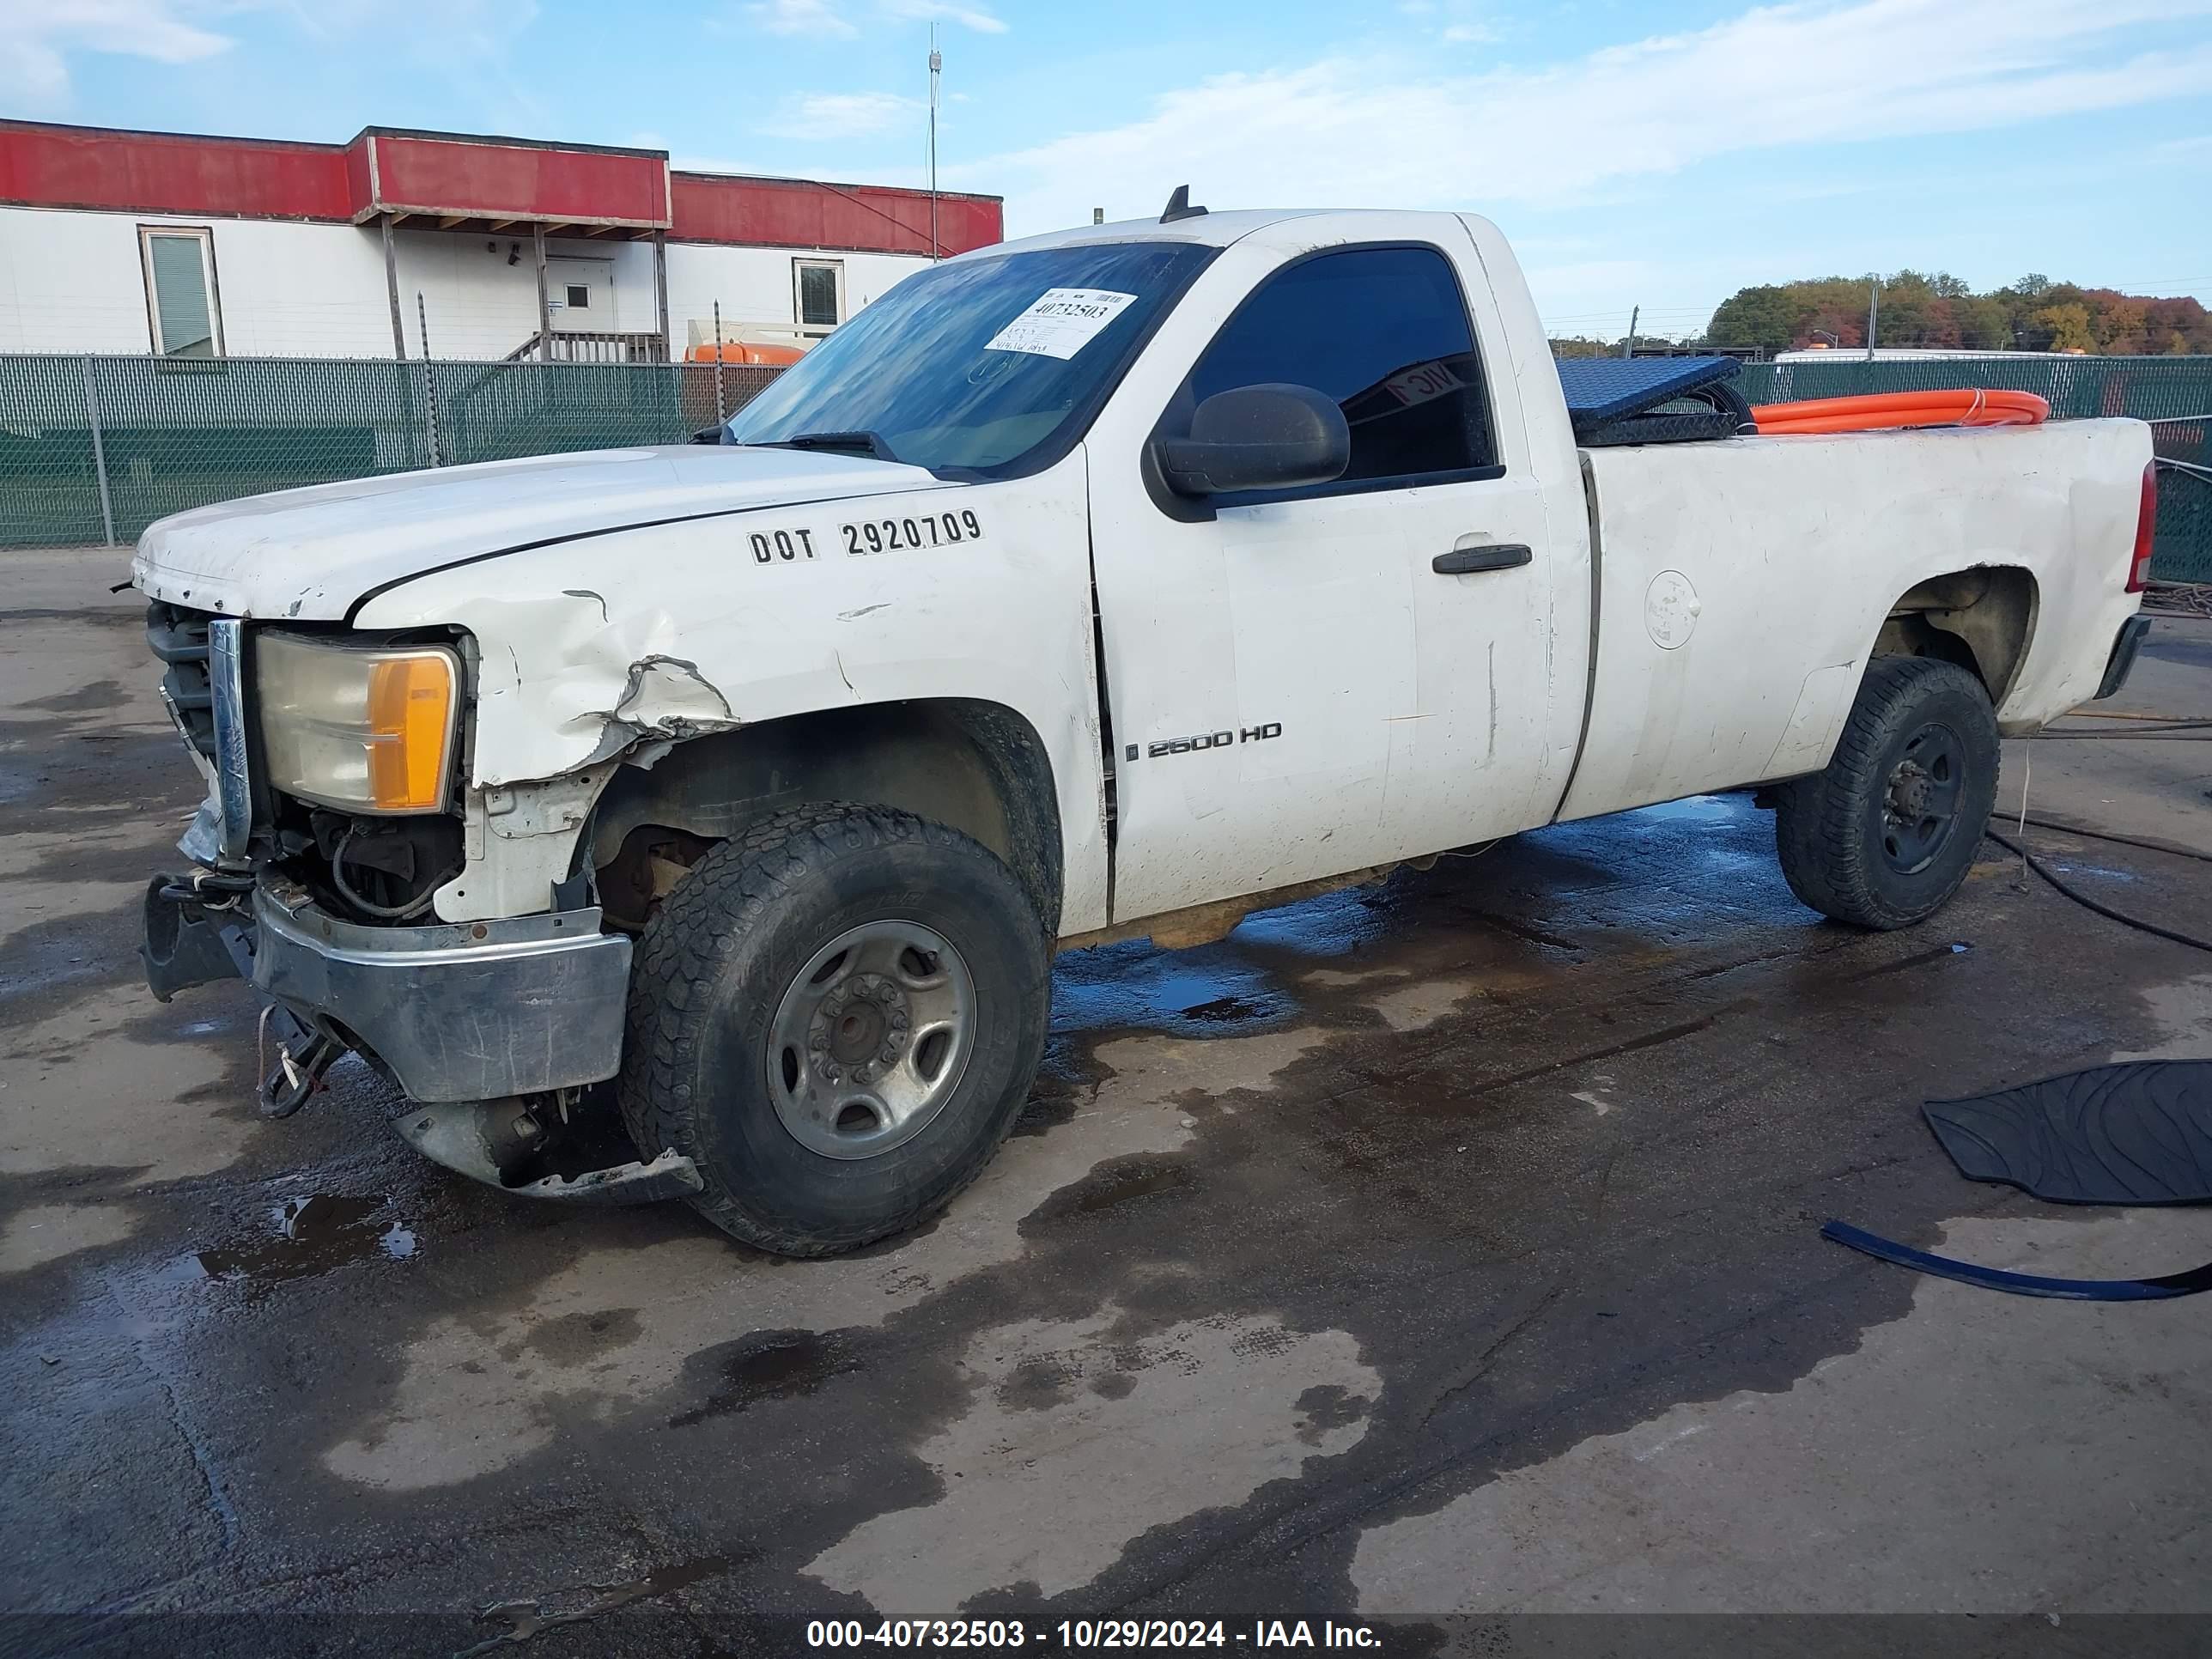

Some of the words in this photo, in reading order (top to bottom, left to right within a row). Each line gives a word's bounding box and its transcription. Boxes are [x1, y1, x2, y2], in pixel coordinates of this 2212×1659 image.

[1035, 302, 1109, 319] 40732503
[750, 528, 814, 563] DOT
[842, 509, 981, 556] 2920709
[1148, 730, 1234, 758] 2500
[1239, 722, 1283, 744] HD
